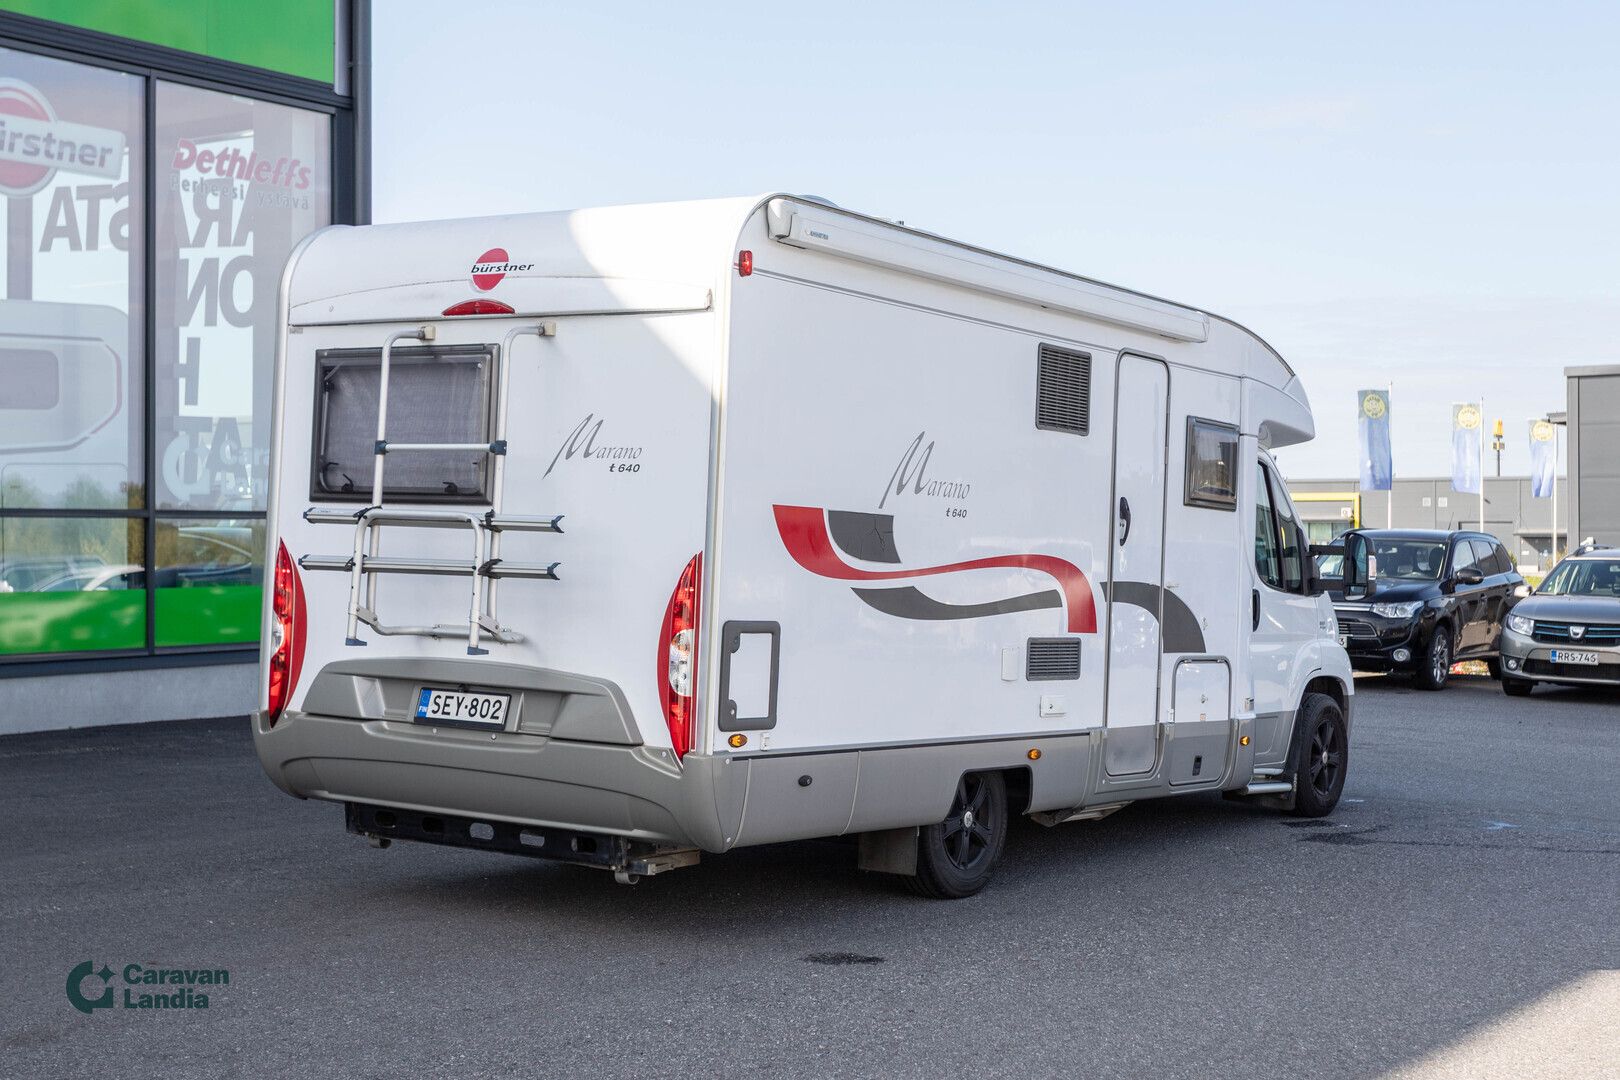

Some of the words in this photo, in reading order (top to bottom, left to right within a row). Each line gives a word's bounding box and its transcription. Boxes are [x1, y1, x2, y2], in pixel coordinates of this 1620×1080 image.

[173, 139, 311, 190] Dethleffs
[471, 263, 534, 274] bürstner
[541, 413, 643, 480] Marano
[617, 463, 641, 473] 640
[878, 431, 970, 509] Marano
[952, 508, 967, 518] 640
[431, 694, 503, 719] SEY-802
